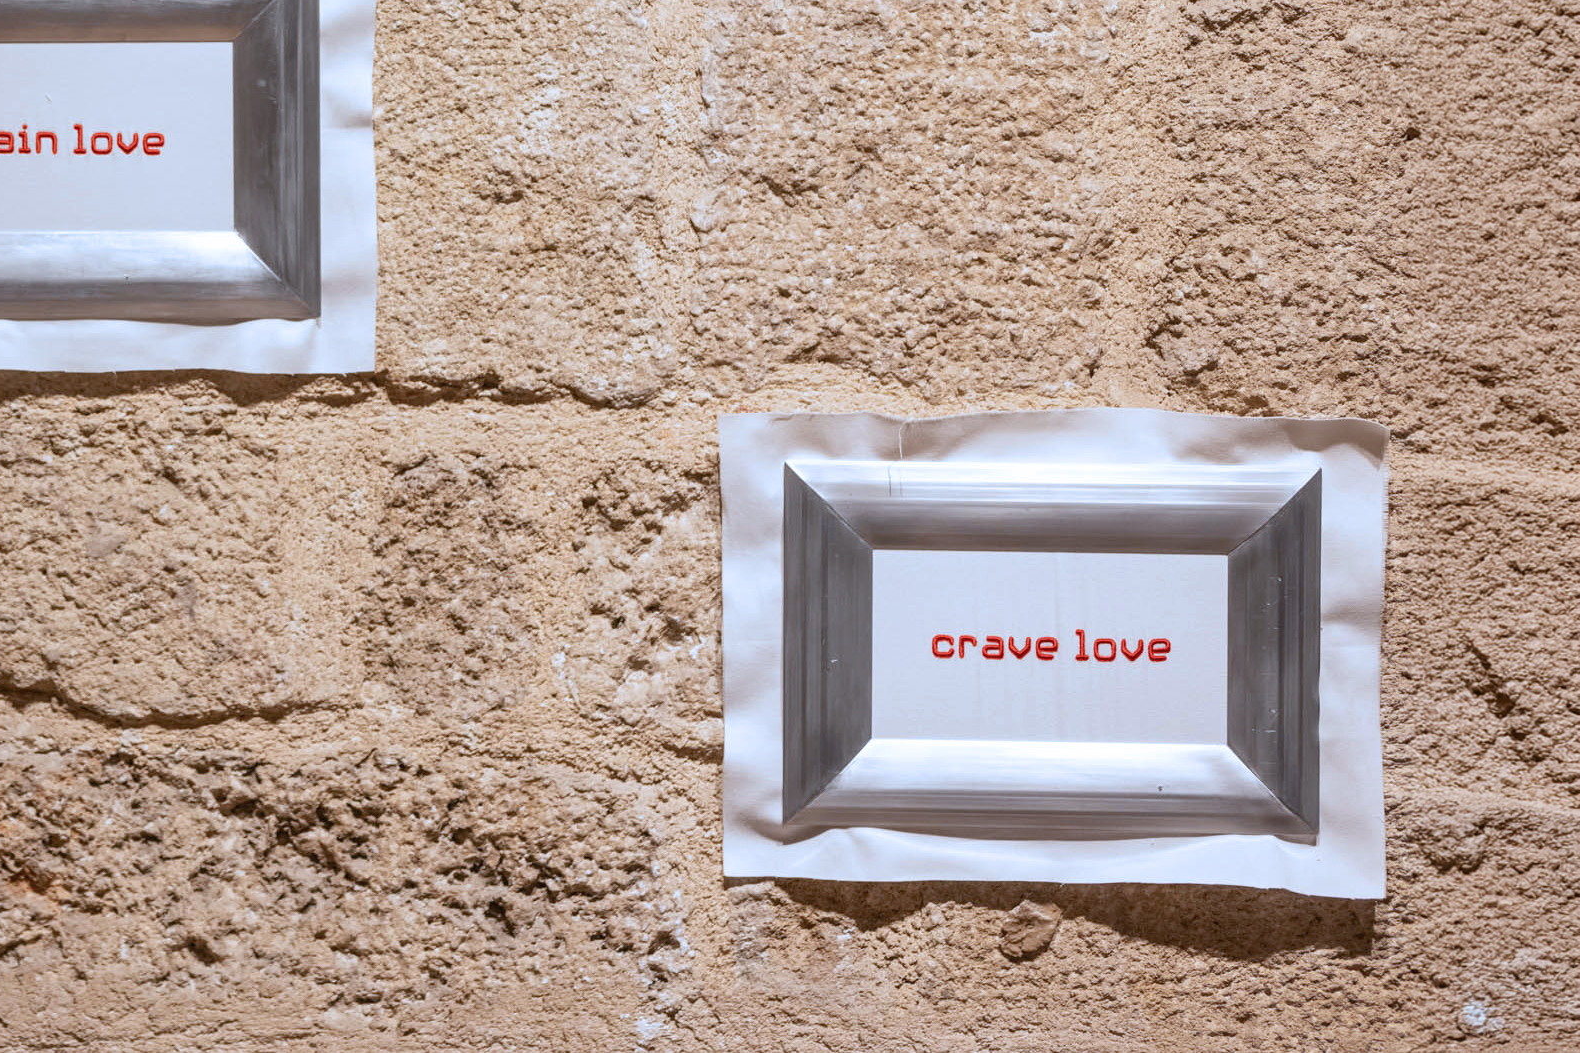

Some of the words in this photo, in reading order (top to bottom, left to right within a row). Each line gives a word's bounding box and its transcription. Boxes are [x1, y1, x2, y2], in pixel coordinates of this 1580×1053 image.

[72, 123, 165, 156] love
[931, 634, 1059, 662] crave
[1075, 628, 1172, 663] love
